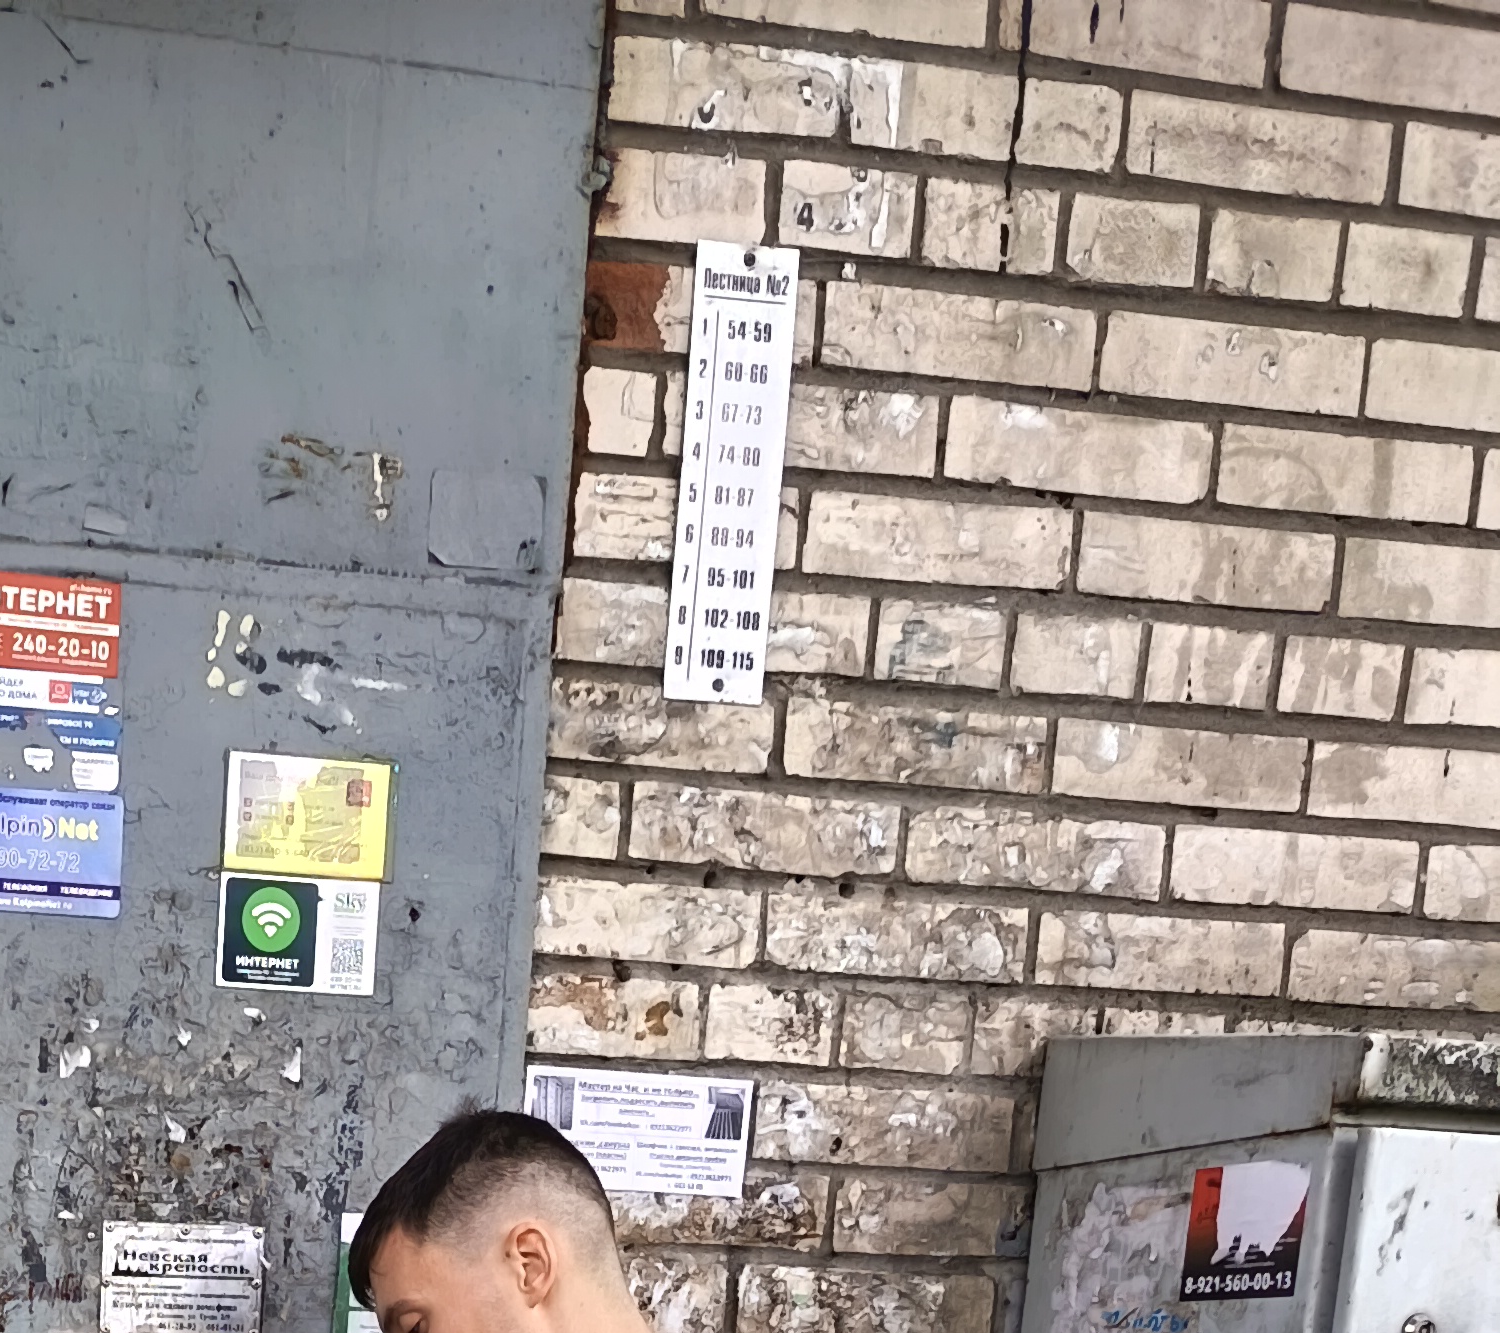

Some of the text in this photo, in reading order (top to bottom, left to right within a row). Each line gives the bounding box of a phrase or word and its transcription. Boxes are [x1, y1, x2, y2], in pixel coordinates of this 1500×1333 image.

[704, 268, 789, 296] Лестница №2
[703, 318, 708, 336] 1
[699, 359, 708, 378] 2
[695, 400, 704, 420] 3
[692, 442, 701, 461] 4
[688, 483, 697, 502] 5
[685, 524, 694, 543] 6
[682, 565, 690, 584] 7
[678, 605, 687, 625] 8
[12, 632, 110, 661] 240-20-10
[675, 645, 683, 665] 9
[7, 689, 37, 700] ДОМА
[235, 956, 299, 969] ИНТЕРНЕТ
[124, 1250, 208, 1263] Невская
[150, 1262, 250, 1275] крепость
[1184, 1271, 1292, 1295] 8-921-560-00-13
